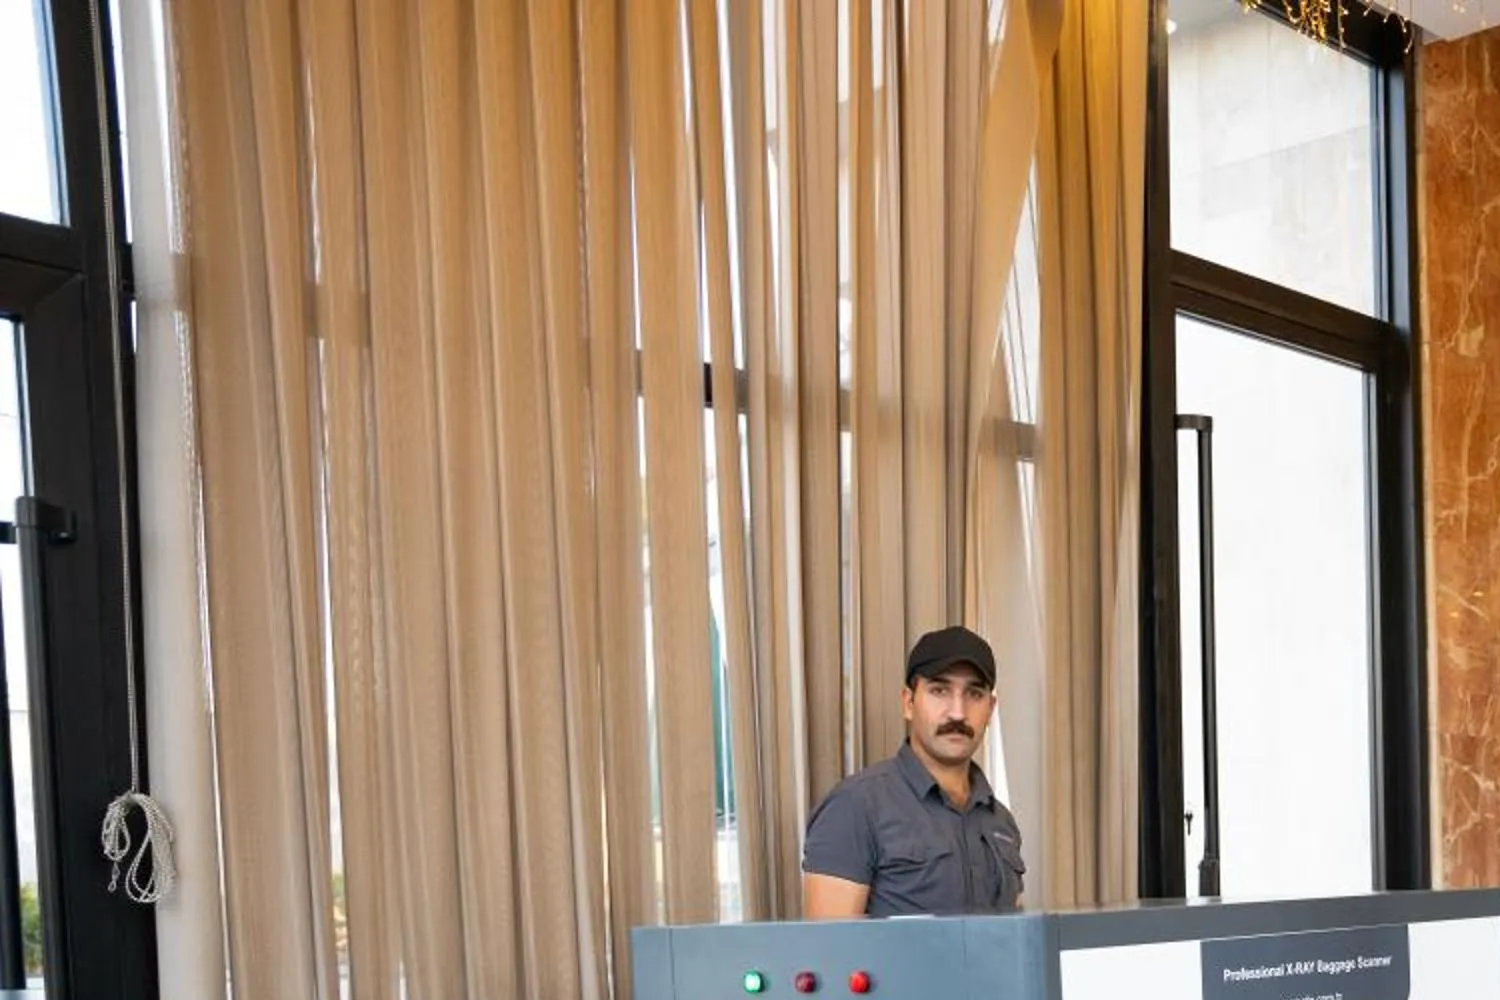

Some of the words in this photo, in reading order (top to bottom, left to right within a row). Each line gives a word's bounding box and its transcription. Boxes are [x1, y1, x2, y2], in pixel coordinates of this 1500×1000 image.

[1223, 964, 1284, 982] Professional
[1286, 960, 1315, 976] X-RAY
[1317, 959, 1356, 976] Baggage
[1357, 955, 1392, 970] Scanner
